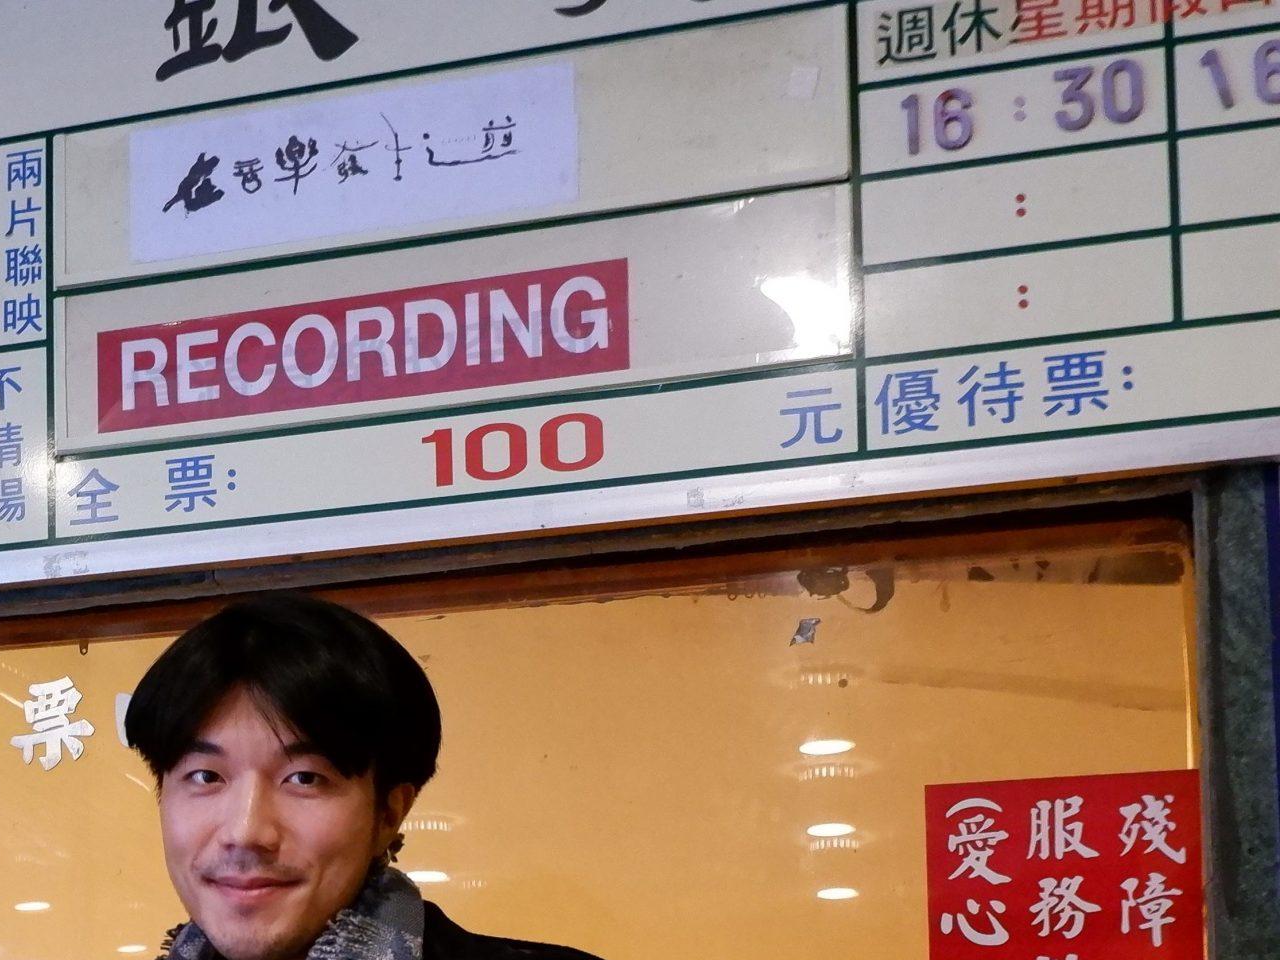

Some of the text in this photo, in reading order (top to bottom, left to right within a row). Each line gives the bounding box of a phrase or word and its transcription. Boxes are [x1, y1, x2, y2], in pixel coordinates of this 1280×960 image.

[3, 148, 43, 335] 兩片聯映
[120, 276, 609, 411] RECORDING
[421, 411, 605, 488] 100
[779, 386, 844, 450] 元
